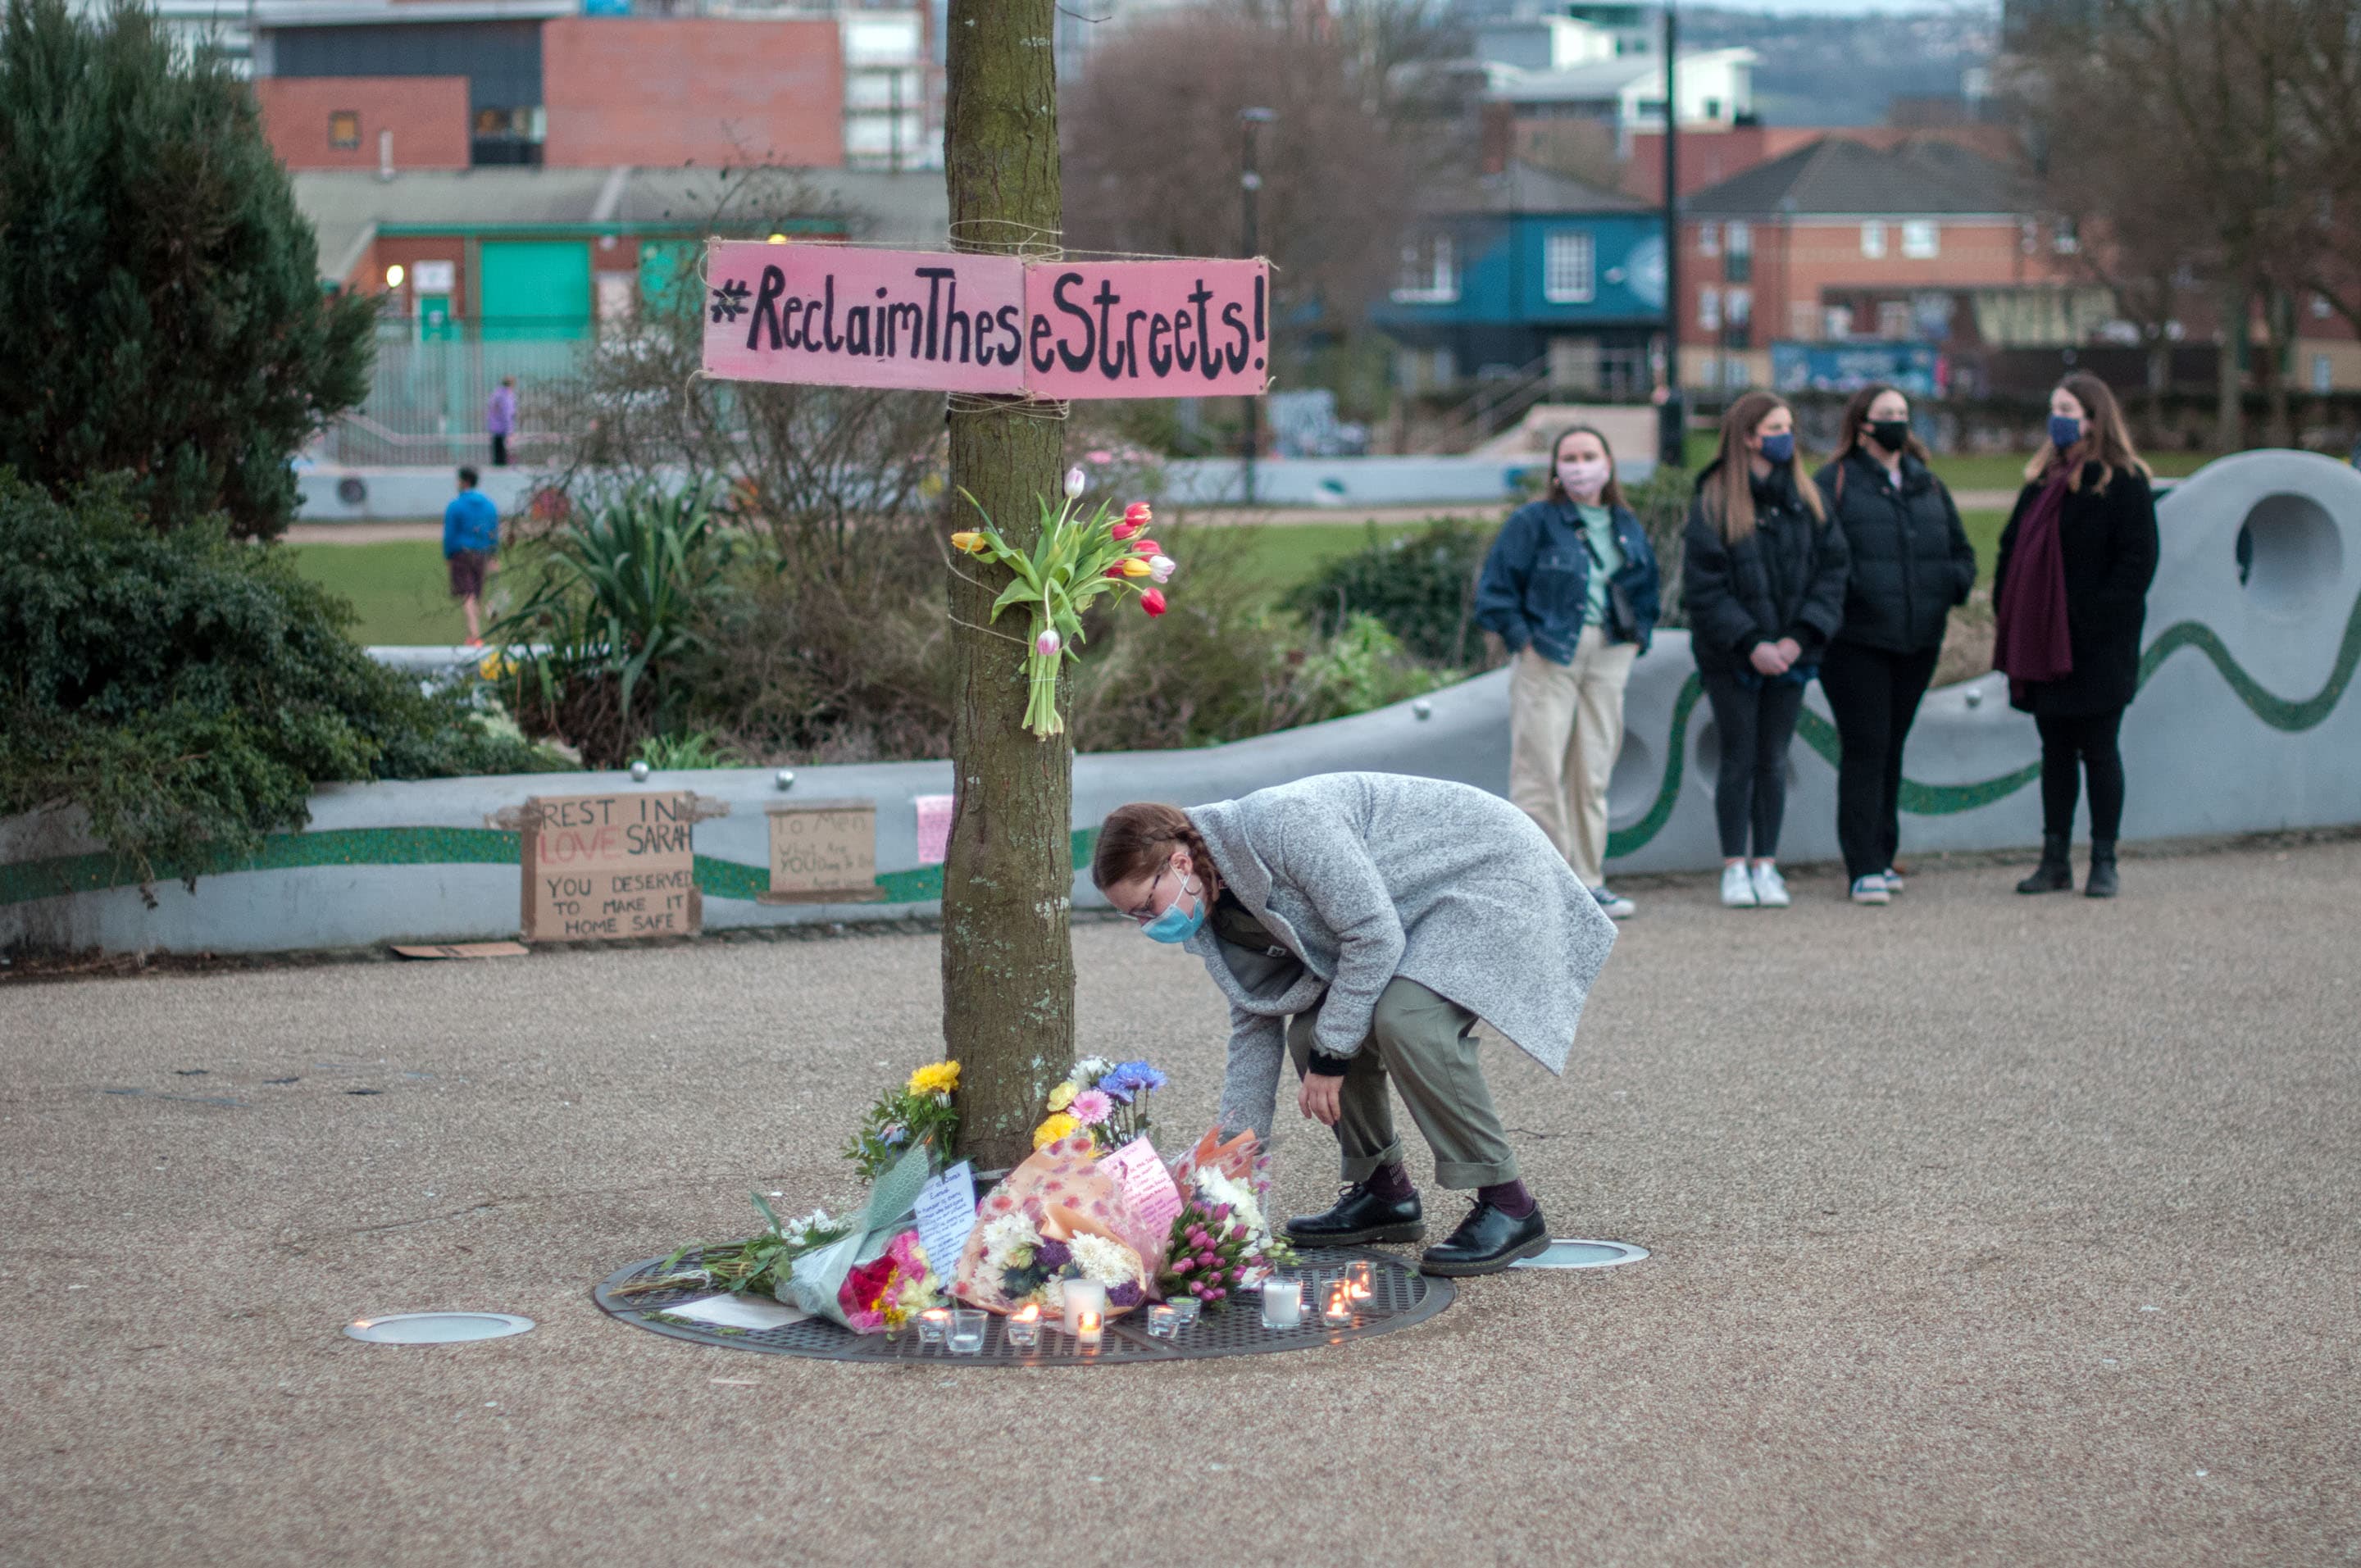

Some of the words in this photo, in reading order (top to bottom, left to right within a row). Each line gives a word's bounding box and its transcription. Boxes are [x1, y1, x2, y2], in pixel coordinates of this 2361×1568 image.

[542, 799, 616, 829] REST
[640, 797, 678, 823] IN
[540, 826, 620, 863] LOVE
[626, 824, 693, 855] SARAH
[547, 876, 592, 898] YOU
[612, 870, 693, 893] DESERVED
[553, 901, 580, 916] TO
[603, 898, 645, 915] MAKE
[666, 895, 684, 909] IT
[566, 917, 617, 934] HOME
[632, 913, 675, 931] SAFE
